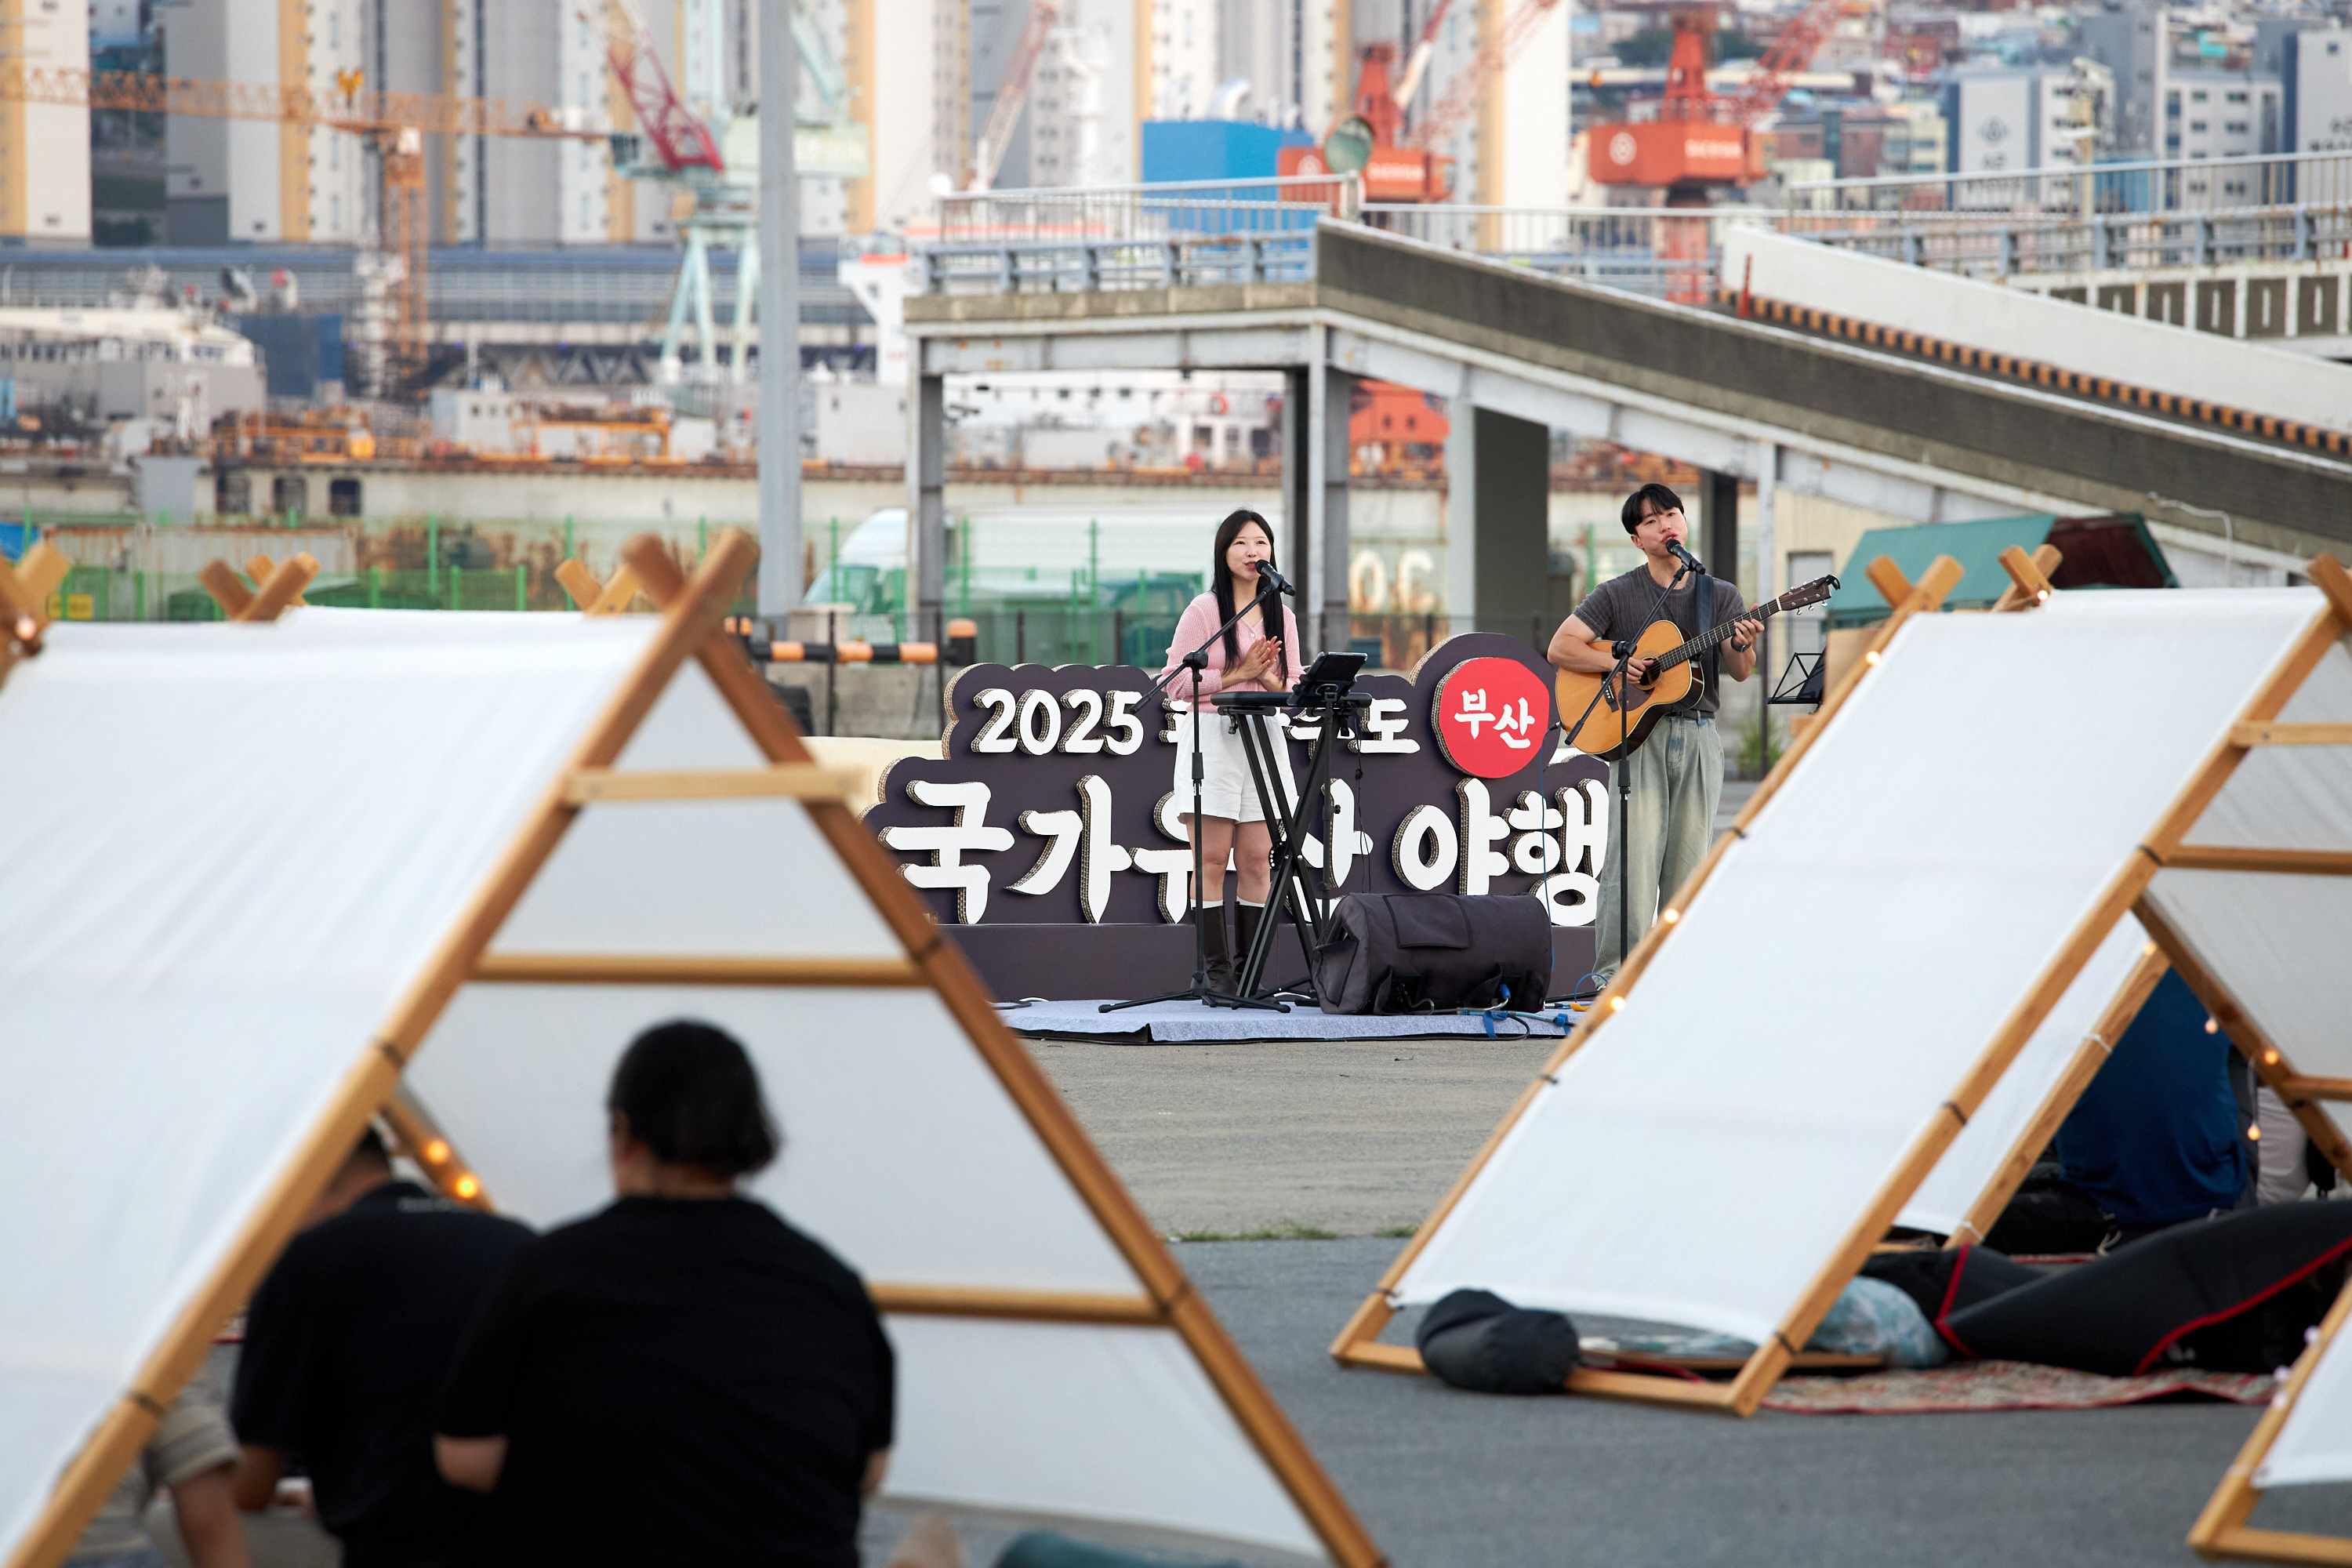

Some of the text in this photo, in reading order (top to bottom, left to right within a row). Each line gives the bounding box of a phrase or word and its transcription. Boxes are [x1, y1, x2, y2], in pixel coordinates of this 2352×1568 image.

[972, 688, 1144, 756] 2025
[1454, 688, 1535, 749] 부산
[1392, 777, 1609, 927] 야행
